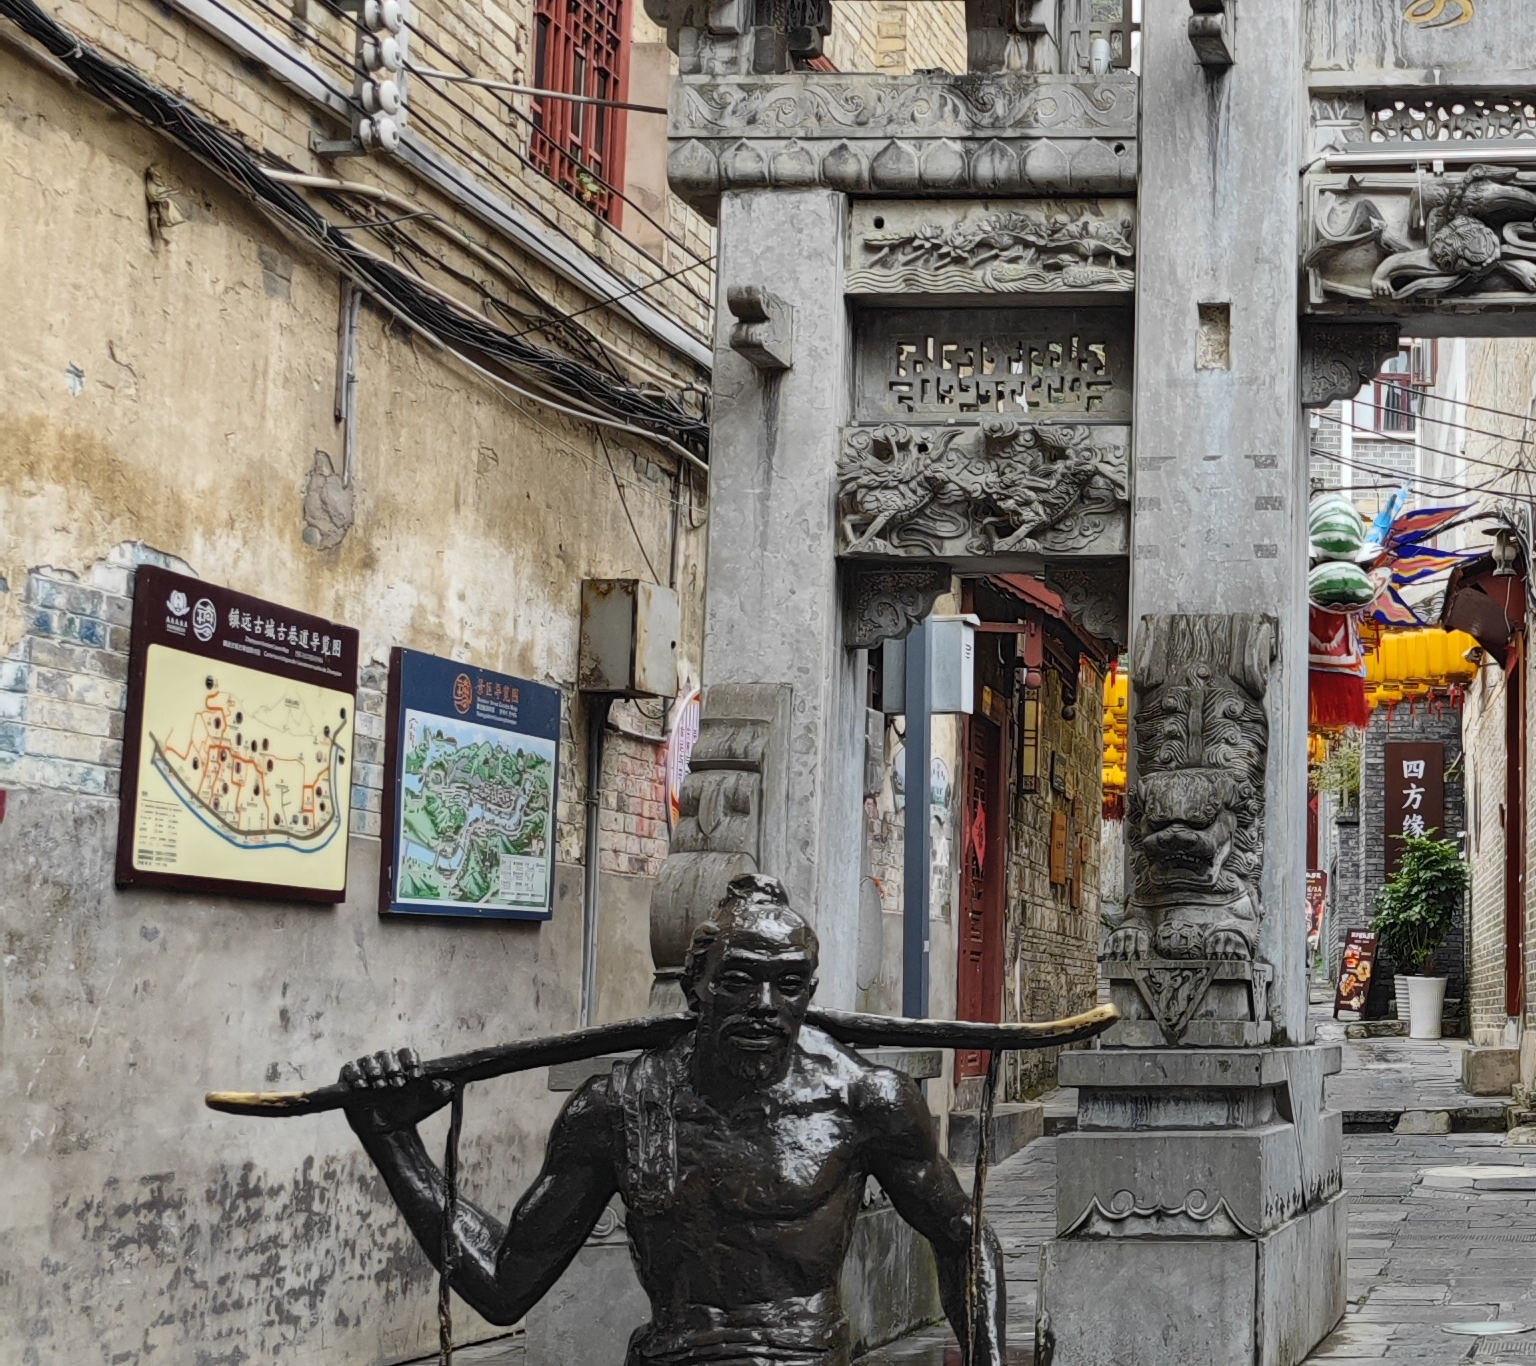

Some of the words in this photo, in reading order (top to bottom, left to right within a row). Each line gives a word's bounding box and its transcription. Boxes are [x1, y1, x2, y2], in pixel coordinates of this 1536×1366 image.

[228, 607, 342, 658] 镇远古城古巷道导览图
